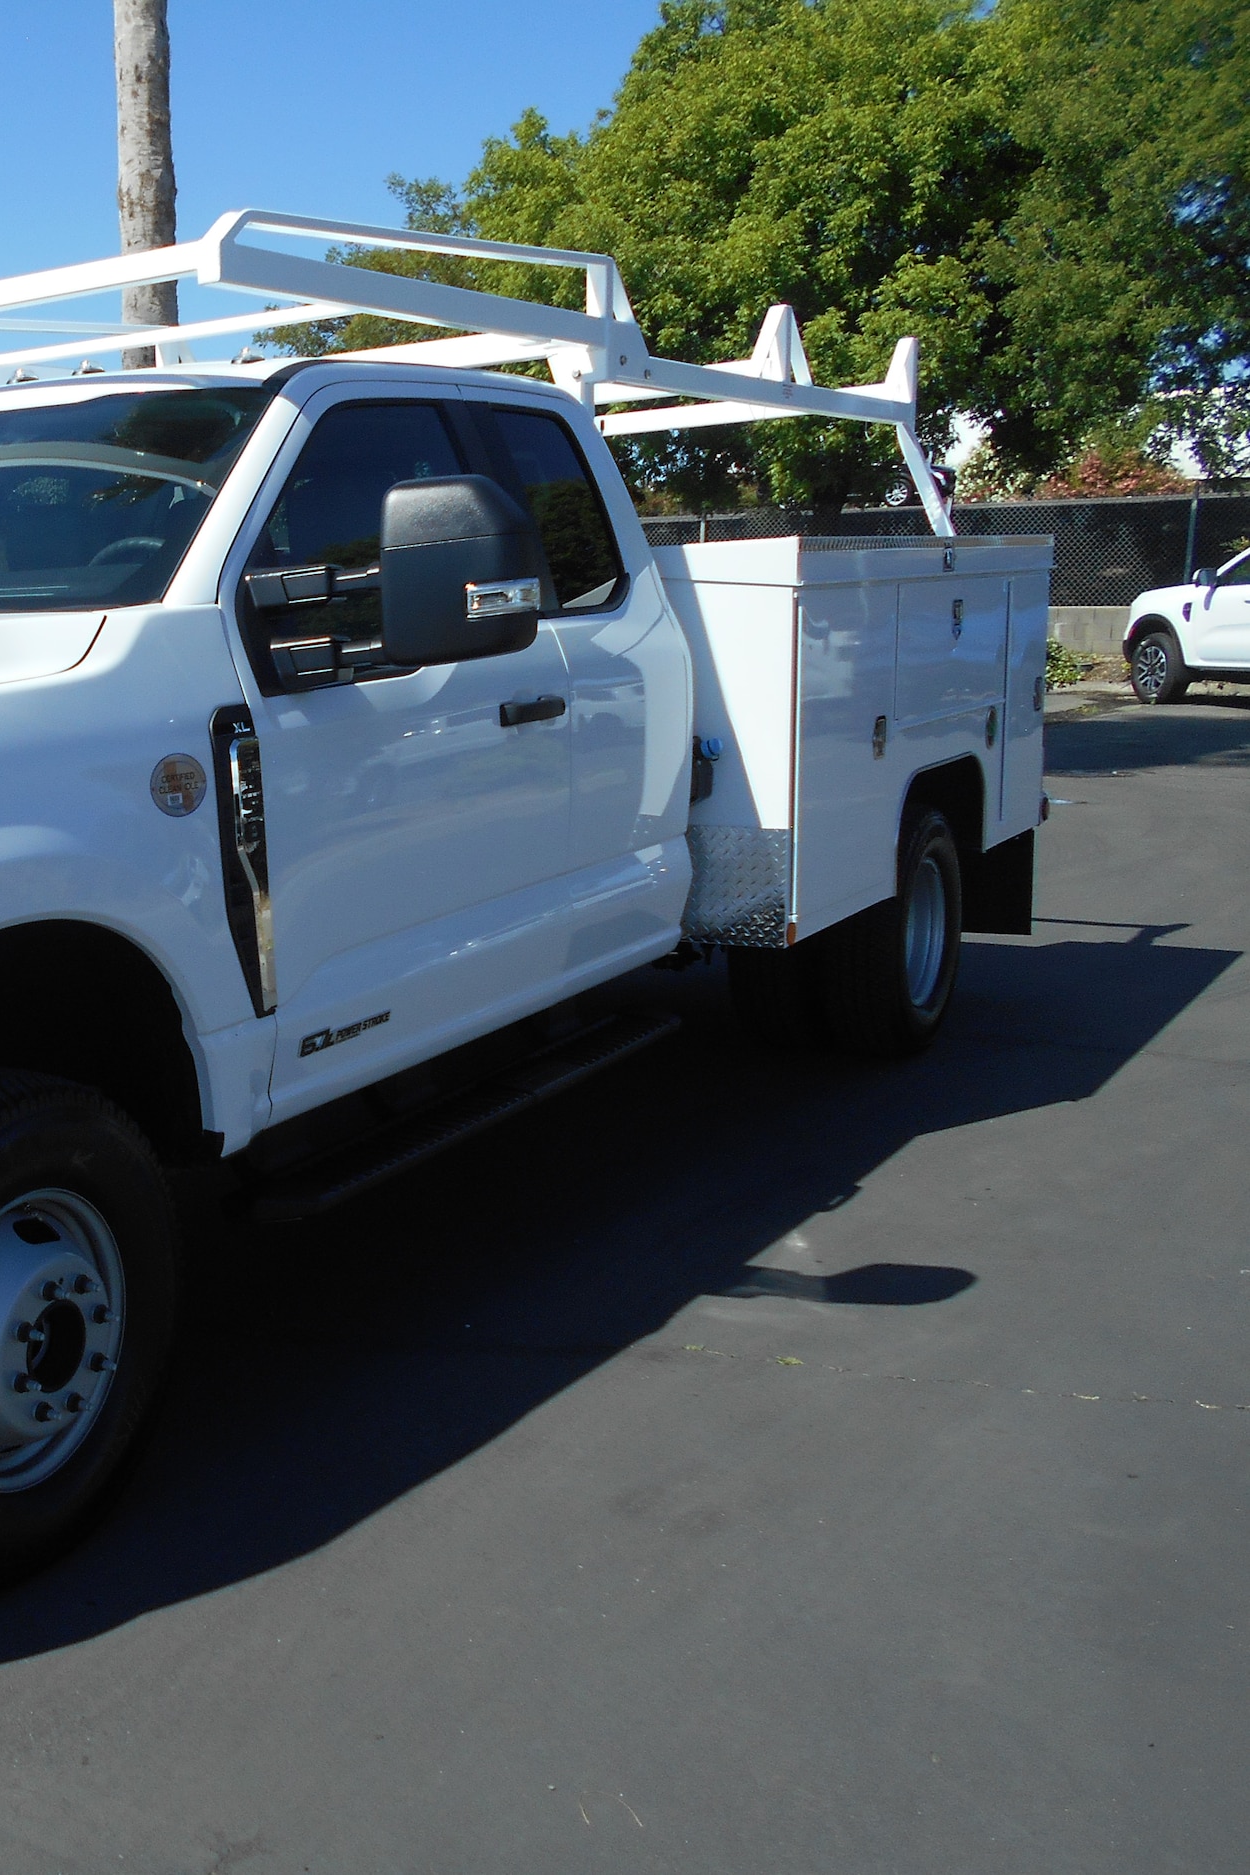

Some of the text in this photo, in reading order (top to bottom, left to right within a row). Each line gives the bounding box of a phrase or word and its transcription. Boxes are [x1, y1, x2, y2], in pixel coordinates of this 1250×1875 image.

[232, 722, 250, 733] XL
[161, 772, 195, 783] CERTIFIED
[158, 783, 182, 794] CLEAN
